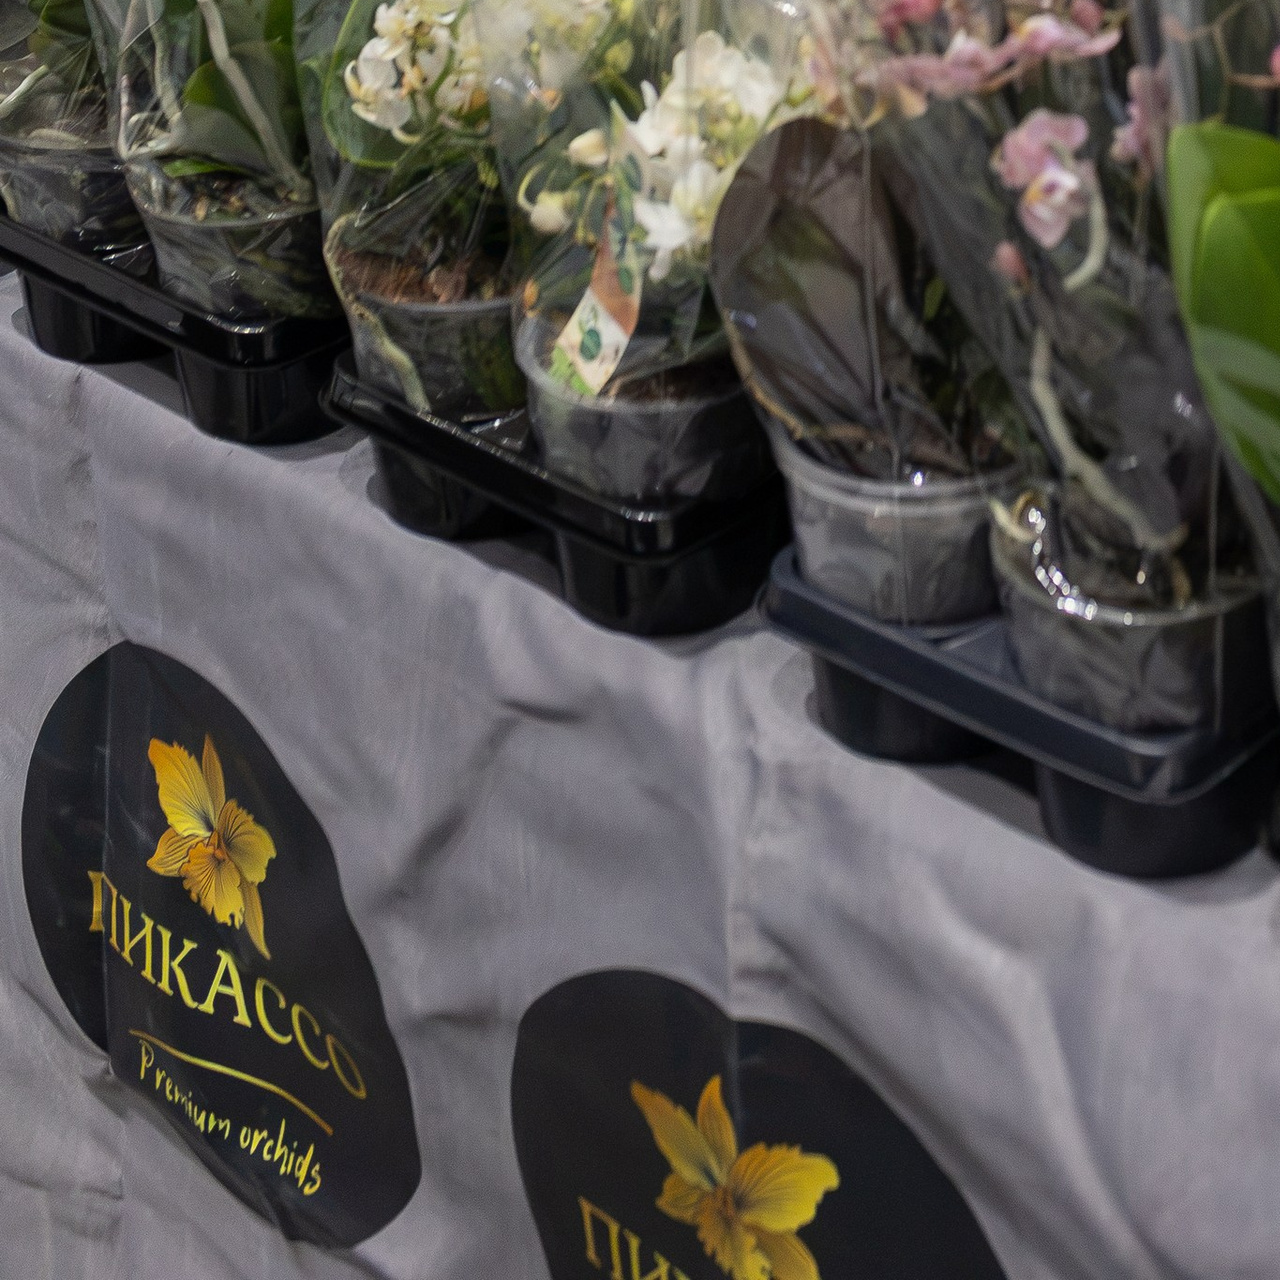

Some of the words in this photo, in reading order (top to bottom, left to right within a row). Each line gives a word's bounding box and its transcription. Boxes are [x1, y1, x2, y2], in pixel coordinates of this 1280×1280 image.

[87, 869, 367, 1100] ПИКАССО
[137, 1039, 232, 1140] Premium
[239, 1117, 322, 1196] orchids
